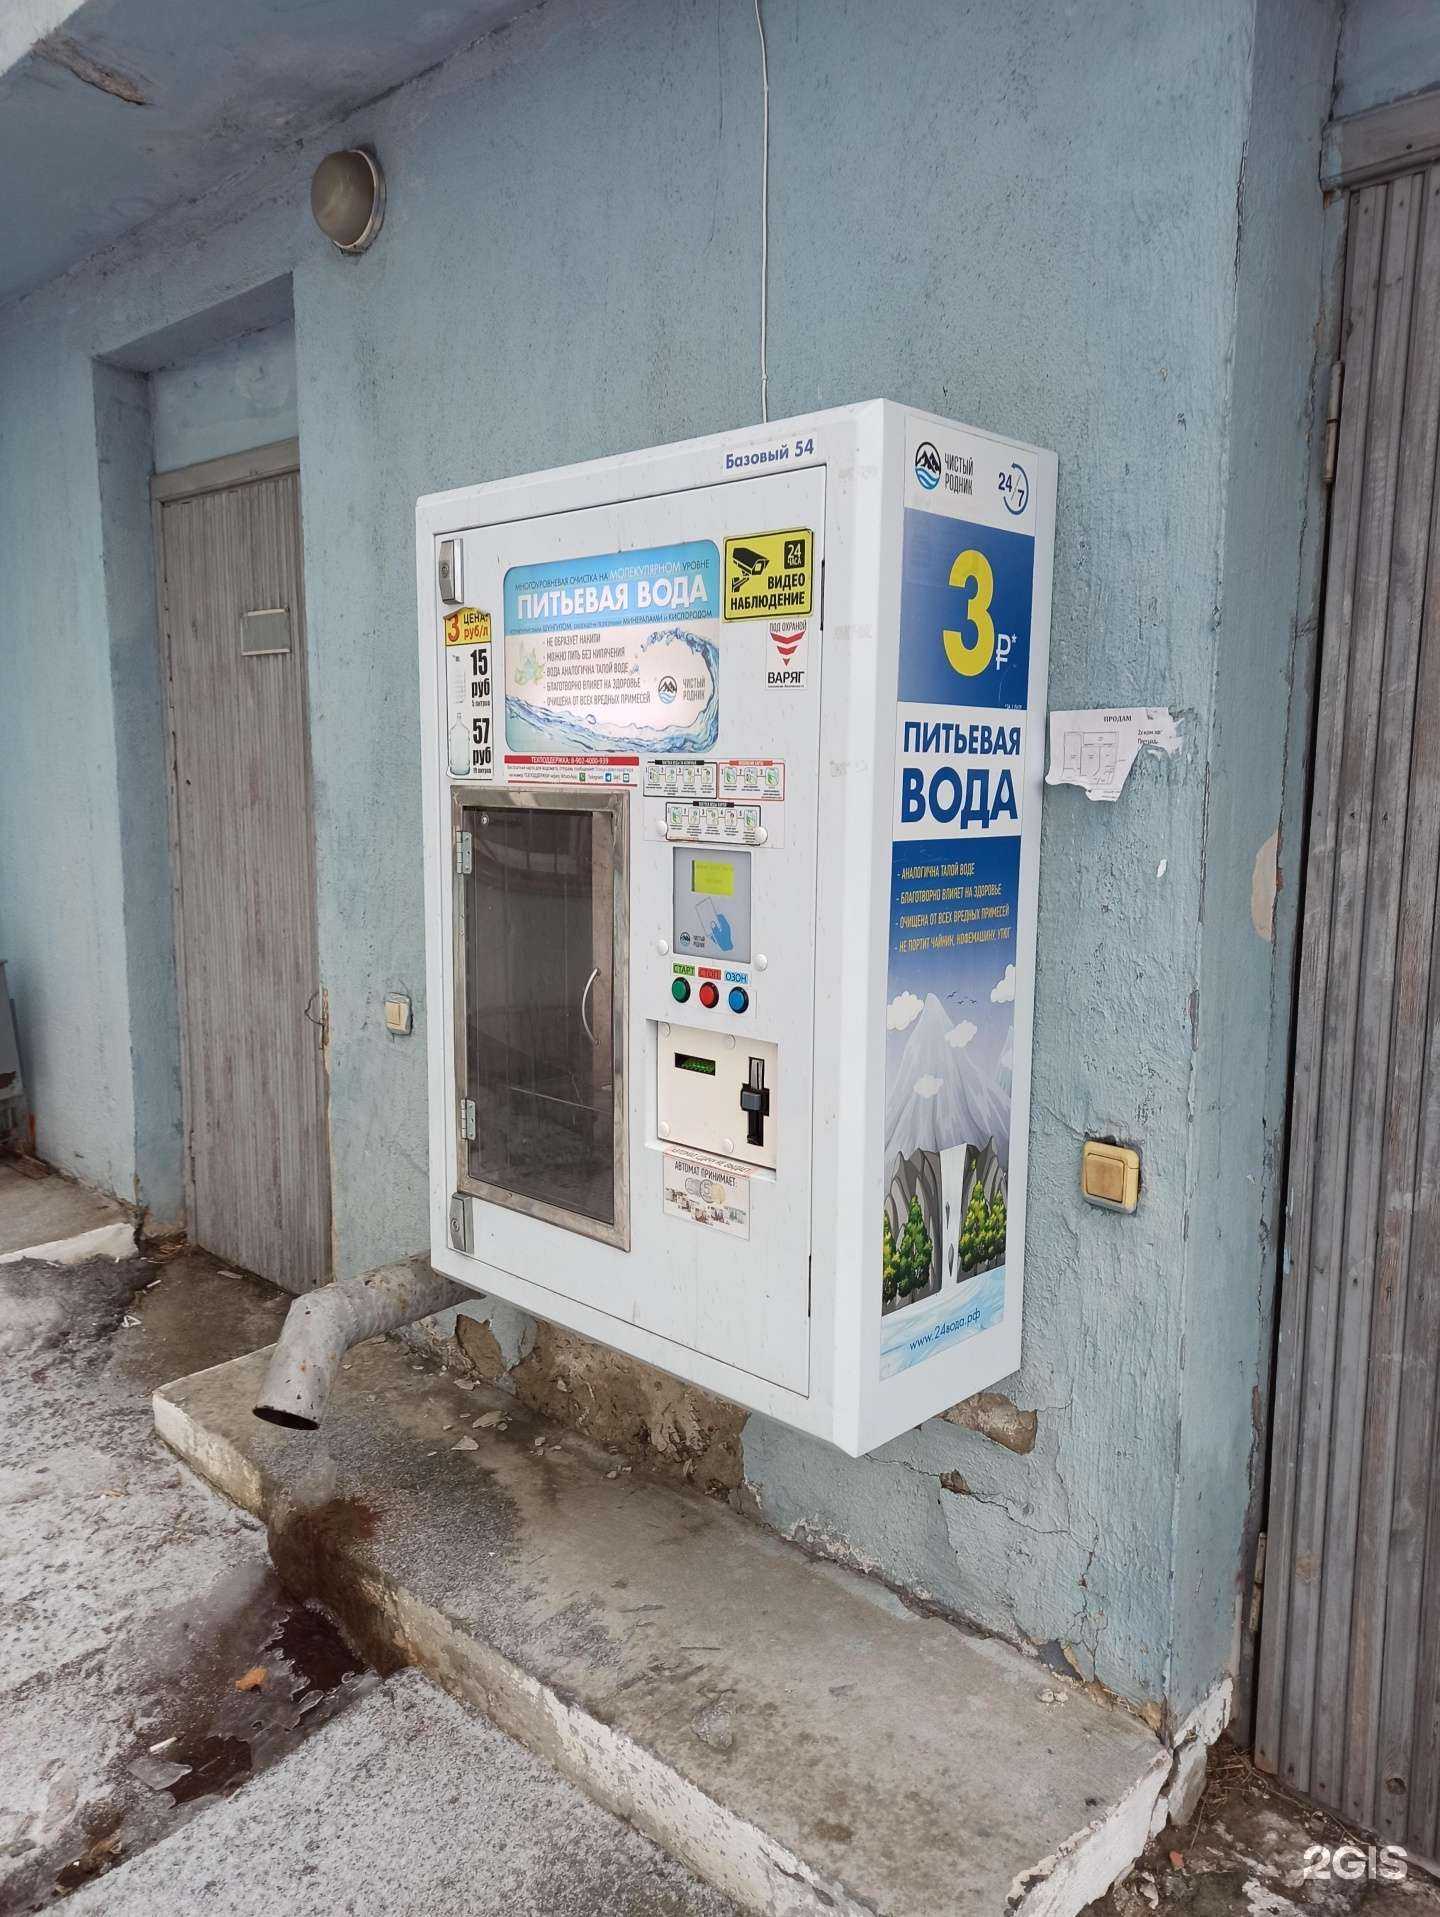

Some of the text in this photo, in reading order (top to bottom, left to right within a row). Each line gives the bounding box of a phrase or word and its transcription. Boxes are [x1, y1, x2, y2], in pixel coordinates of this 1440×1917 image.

[725, 438, 815, 470] Базовый 54
[944, 453, 974, 476] ЧИСТЫЙ
[944, 472, 973, 495] РОДНИК
[787, 543, 802, 558] 24
[515, 560, 711, 591] МНОГОУРОВНЕВАЯ ОЧИСТКА НА МОЛЕКУЛЯРНОМ УРОВНЕ
[767, 573, 806, 591] ВИДЕО
[517, 574, 709, 620] ПИТЬЕВАЯ ВОДА
[730, 591, 805, 611] НАБЛЮДЕНИЕ
[623, 613, 664, 624] МИНЕРАЛАМИ
[668, 609, 713, 620] КИСЛОРОДОМ
[942, 549, 995, 677] 3
[447, 613, 460, 642] 3
[463, 626, 489, 639] руб/л
[769, 620, 807, 633] ПОД ОХРАНОЙ
[546, 634, 601, 646] НЕ ОБРАЗУЕТ НАКИПИ
[470, 648, 488, 676] 15
[546, 647, 625, 662] МОЖНО ПИТЬ БЕЗ КИПЯЧЕНИЯ
[546, 662, 629, 677] ВОДА АНАЛОГИЧНА ТАЛОЙ ВОДЕ
[767, 671, 805, 684] ВАРЯГ
[471, 678, 490, 698] руб
[546, 677, 641, 692] БЛАГОТВОРНО ВЛИЯЕТ НА ЗДОРОВЬЕ
[682, 677, 706, 688] ЧИСТЫЙ
[547, 691, 651, 707] ОЧИЩЕНА ОТ ВСЕХ ВРЕДНЫХ ПРИМЕСЕЙ
[682, 689, 705, 701] РОДНИК
[1103, 715, 1132, 723] ПРОДАМ
[472, 718, 490, 745] 57
[903, 721, 1021, 755] ПИТЬЕВАЯ
[473, 746, 492, 766] руб
[901, 766, 1019, 830] ВОДА
[901, 862, 976, 880] АНАЛОГИЧНА ТАЛОЙ ВОДЕ
[900, 883, 1002, 904] БЛАГОТВОРНО ВЛИЯЕТ НА ЗДОРОВЬЕ
[900, 903, 1010, 928] ОЧИЩЕНА ОТ ВСЕХ ВРЕДНЫХ ПРИМЕСЕЙ
[899, 940, 908, 952] НЕ
[908, 937, 930, 952] ПОРТИТ
[997, 927, 1012, 940] УТЮГ
[673, 964, 694, 975] СТАРТ
[725, 971, 747, 983] ОЗОН
[675, 1161, 699, 1176] АВТОМАТ
[909, 1307, 981, 1351] www.24вода.рф
